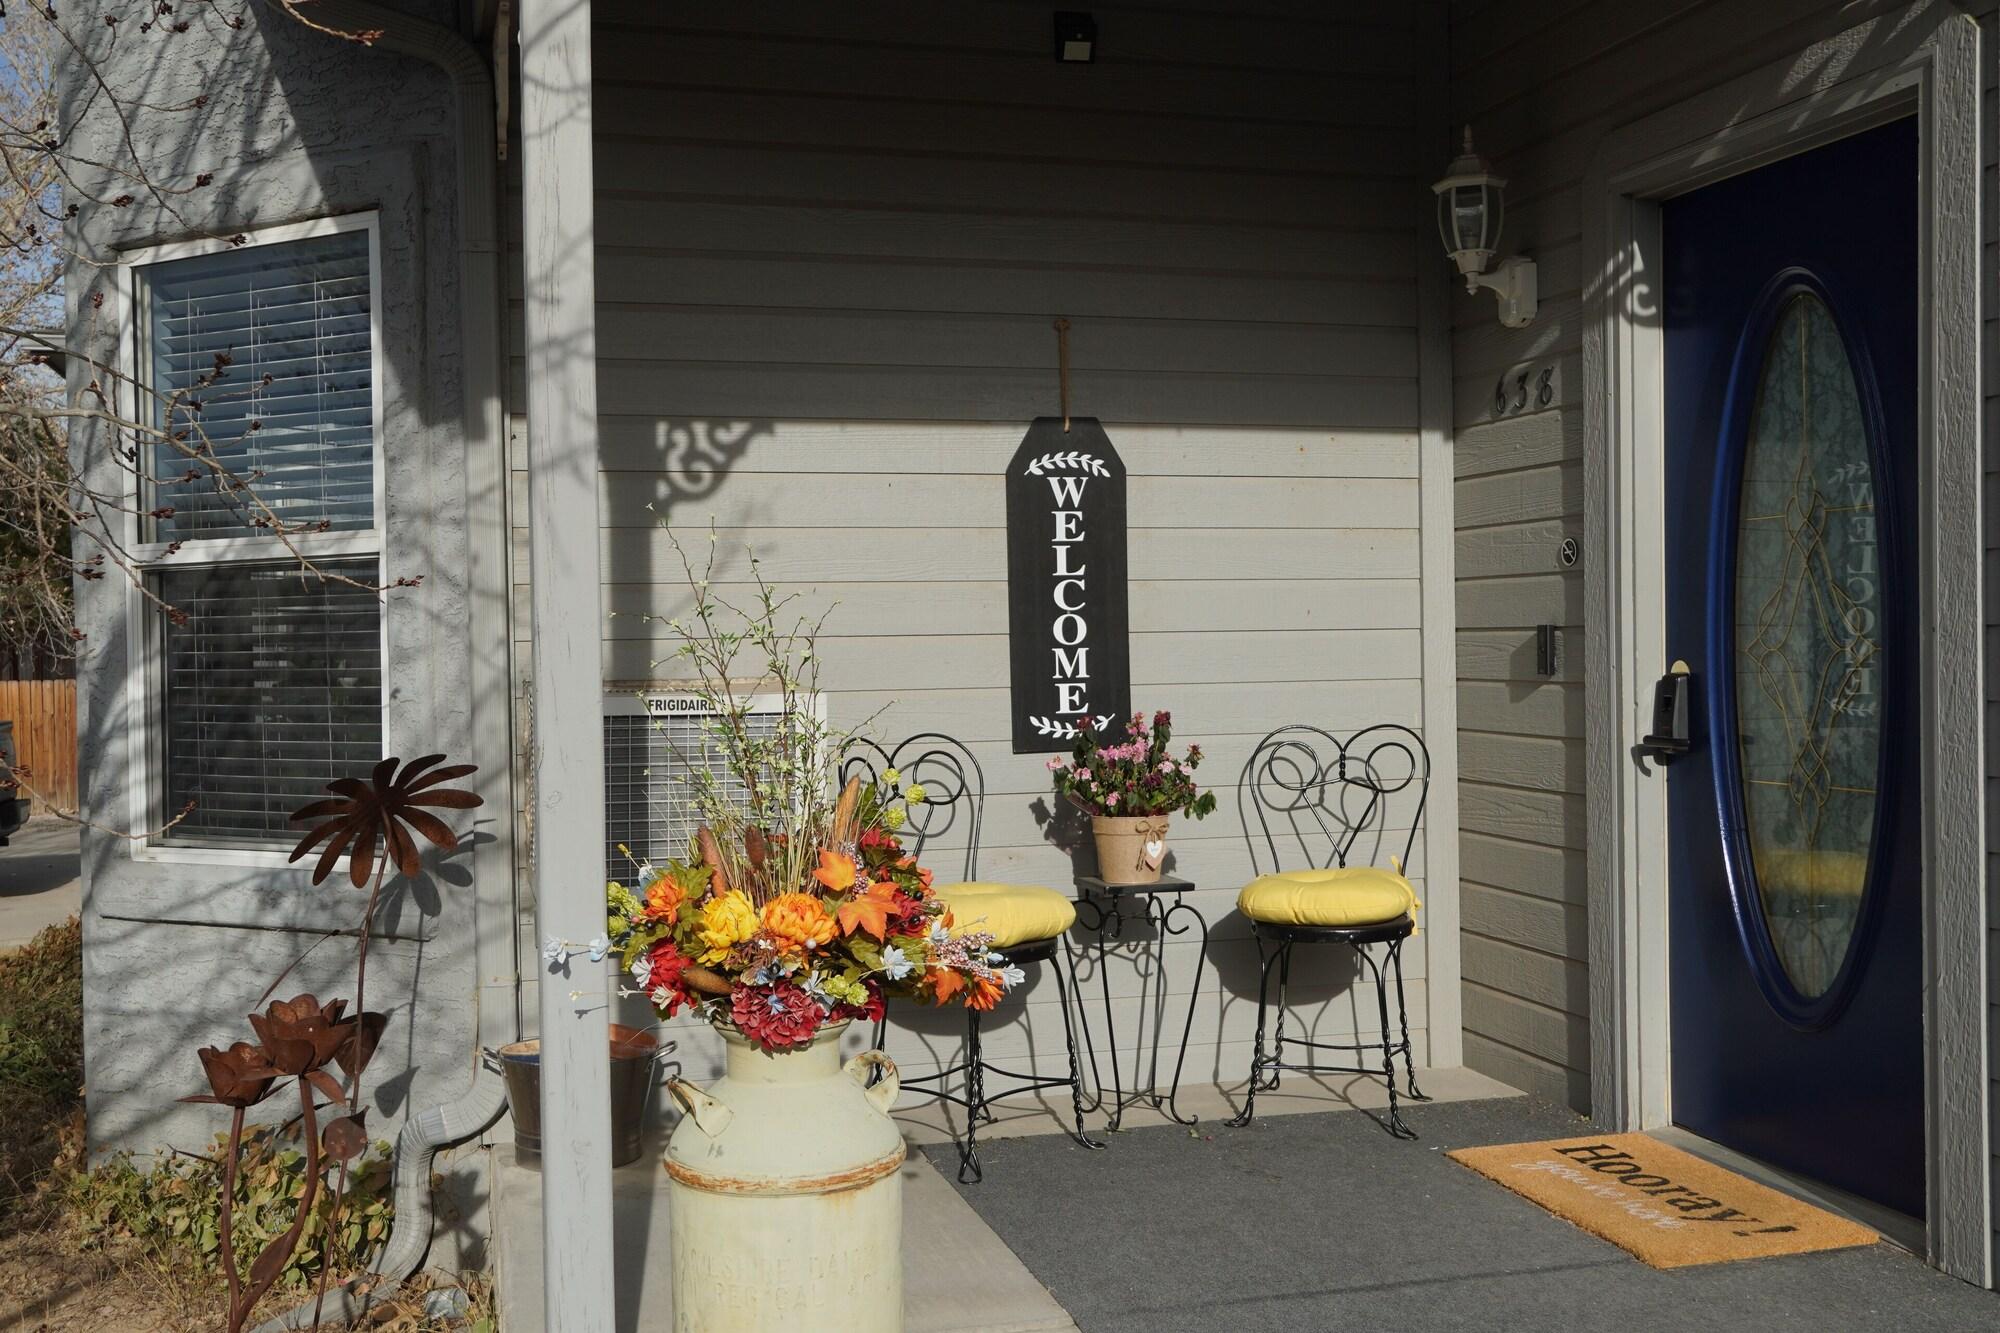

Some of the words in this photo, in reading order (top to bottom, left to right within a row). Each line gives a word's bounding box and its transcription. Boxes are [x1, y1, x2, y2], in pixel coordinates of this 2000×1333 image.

[1495, 366, 1554, 415] 638
[1046, 475, 1091, 715] WELCOME
[1552, 1142, 1799, 1238] Hooray!
